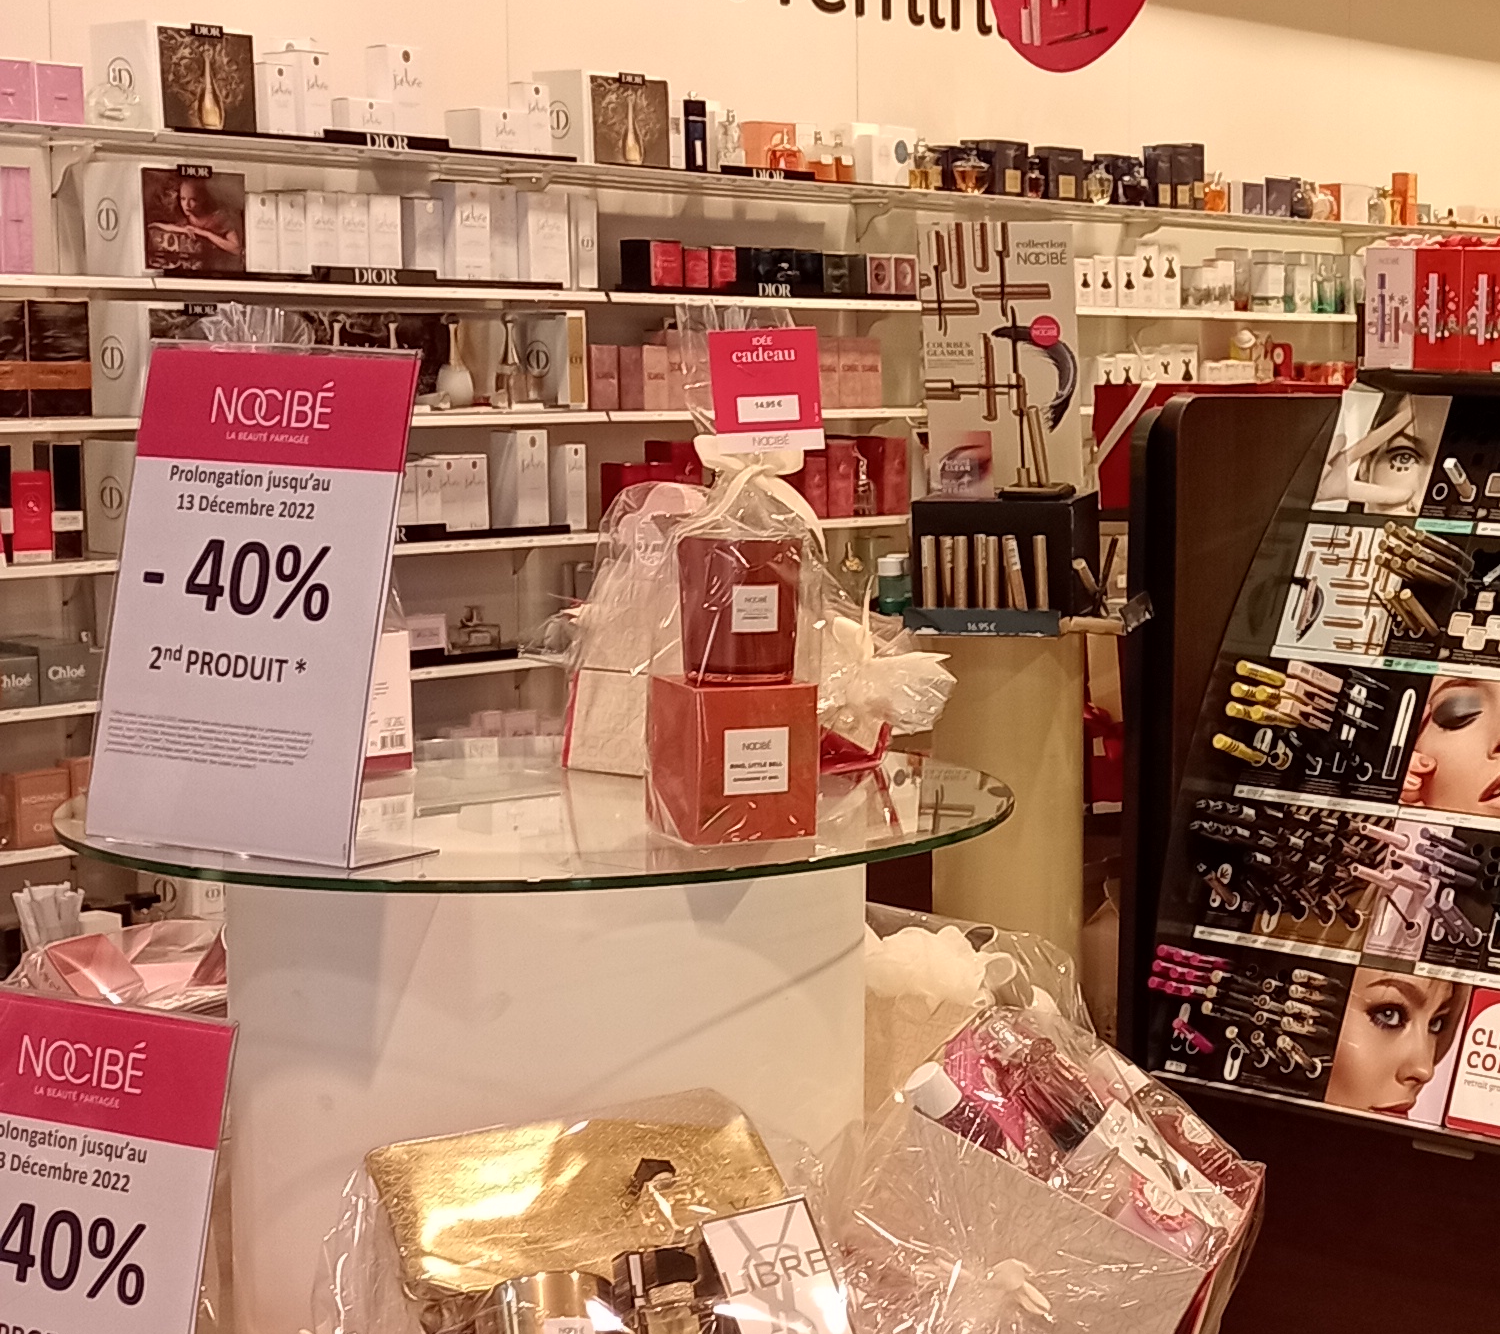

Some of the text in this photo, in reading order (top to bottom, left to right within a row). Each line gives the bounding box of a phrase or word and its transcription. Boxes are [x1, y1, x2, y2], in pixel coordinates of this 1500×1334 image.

[194, 24, 221, 37] DIOR
[366, 133, 409, 151] DIOR
[181, 165, 210, 178] DIOR
[1016, 240, 1067, 251] collection
[1016, 249, 1067, 266] NOCIBÉ
[354, 268, 399, 285] DIOR
[758, 282, 792, 298] DIOR
[751, 336, 774, 346] IDÉE
[731, 348, 796, 363] cadeau
[926, 348, 975, 358] GLAMOUR
[210, 380, 335, 430] NOCIBÉ
[226, 430, 309, 445] LA BEAUTÉ PARTAGÉE
[752, 435, 790, 447] NOCIBÉ
[168, 464, 332, 494] Prolongation jusqu'au
[176, 493, 316, 520] 13 Décembre 2022
[185, 539, 332, 622] 40%
[148, 644, 183, 670] 2nd
[185, 649, 289, 683] PRODUIT
[0, 672, 33, 688] hloé
[47, 664, 87, 681] Chloé
[742, 739, 772, 751] NOCIBÉ
[18, 1034, 147, 1095] NOCIBÉ
[1463, 1079, 1489, 1090] retrait
[34, 1085, 121, 1110] LA BEAUTÉ PARTAGÉE
[79, 1133, 148, 1164] jusqu'au
[9, 1153, 89, 1186] Décembre
[91, 1168, 131, 1194] 2022
[0, 1202, 147, 1306] 40%
[721, 1247, 831, 1300] LIBRE
